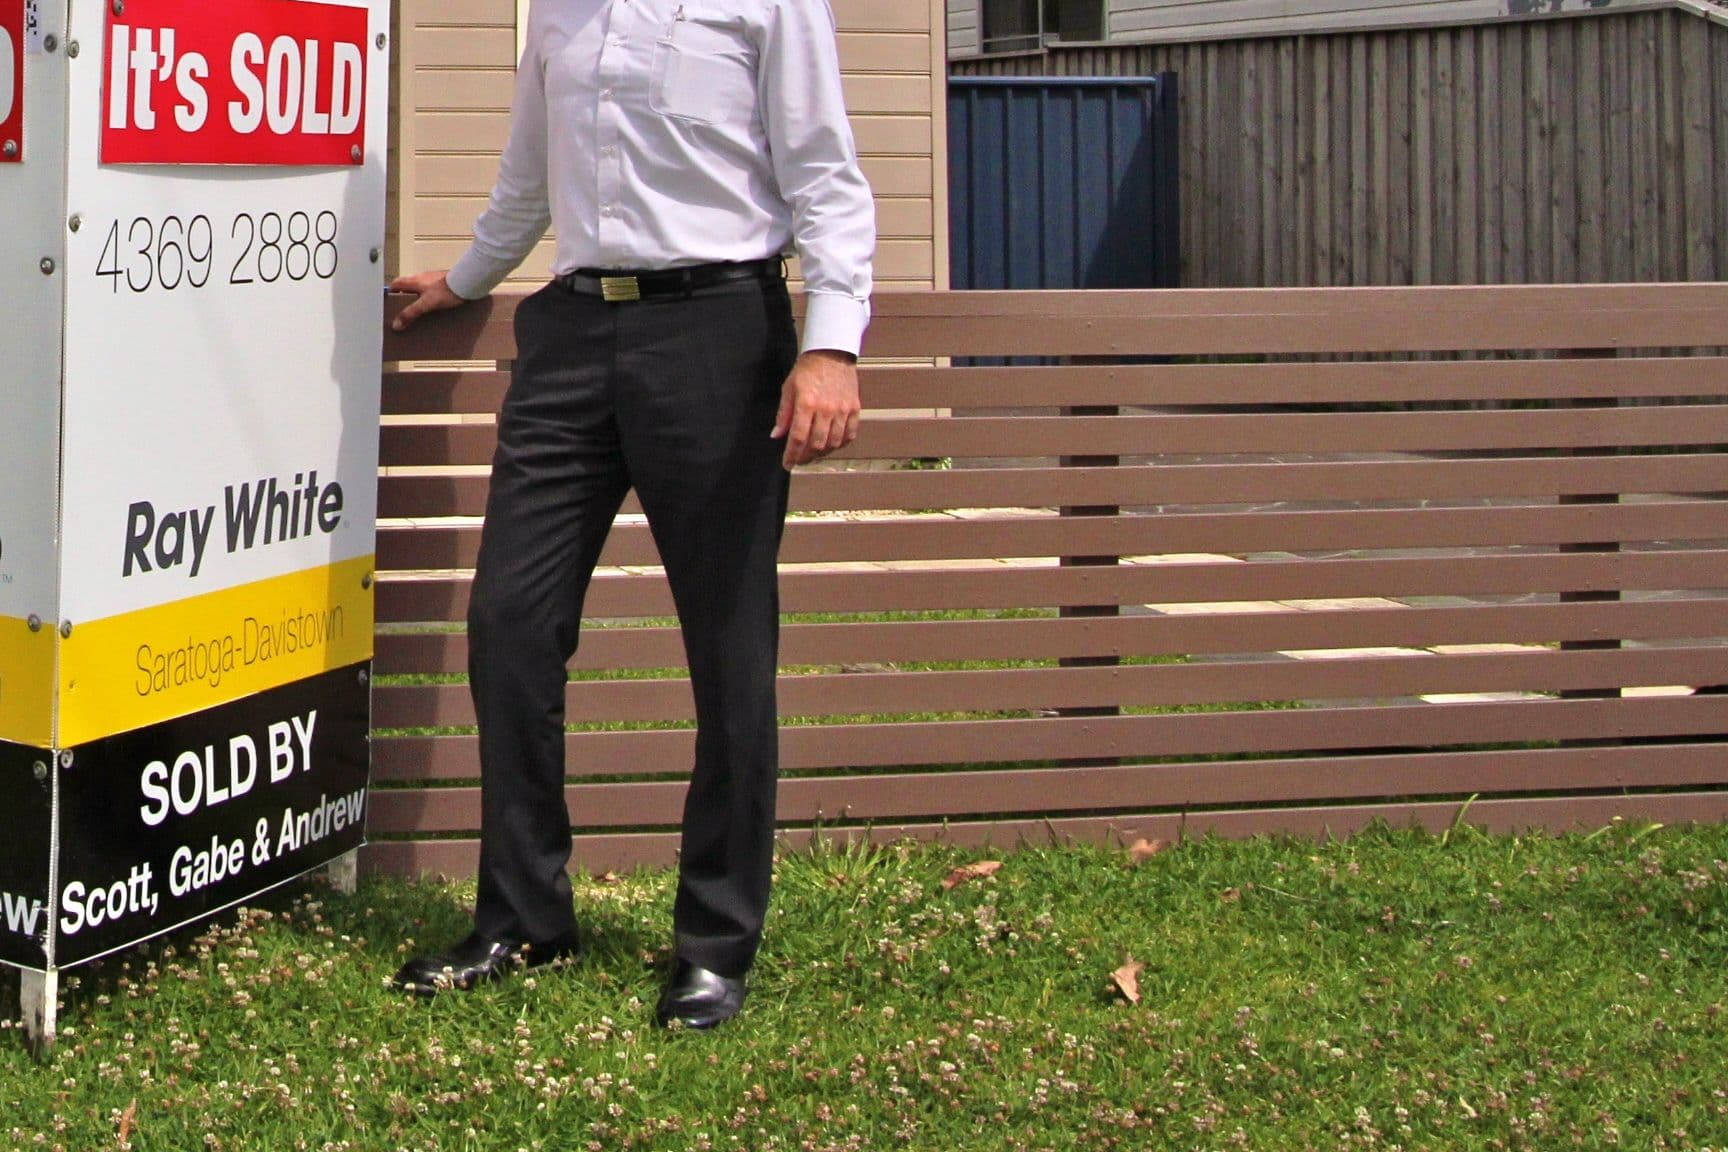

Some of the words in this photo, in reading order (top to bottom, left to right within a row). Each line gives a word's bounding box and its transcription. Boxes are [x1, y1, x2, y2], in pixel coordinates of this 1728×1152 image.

[108, 23, 208, 133] It's
[228, 31, 362, 136] SOLD
[95, 213, 213, 293] 4369
[229, 210, 338, 287] 2888
[122, 500, 215, 577] Ray
[224, 470, 344, 554] White
[135, 604, 344, 698] Saratoga-Davistown
[140, 734, 257, 826] SOLD
[267, 711, 317, 785] BY
[60, 861, 160, 935] Scott,
[169, 835, 245, 898] Gabe
[251, 816, 272, 862] &
[276, 787, 365, 856] Andrew
